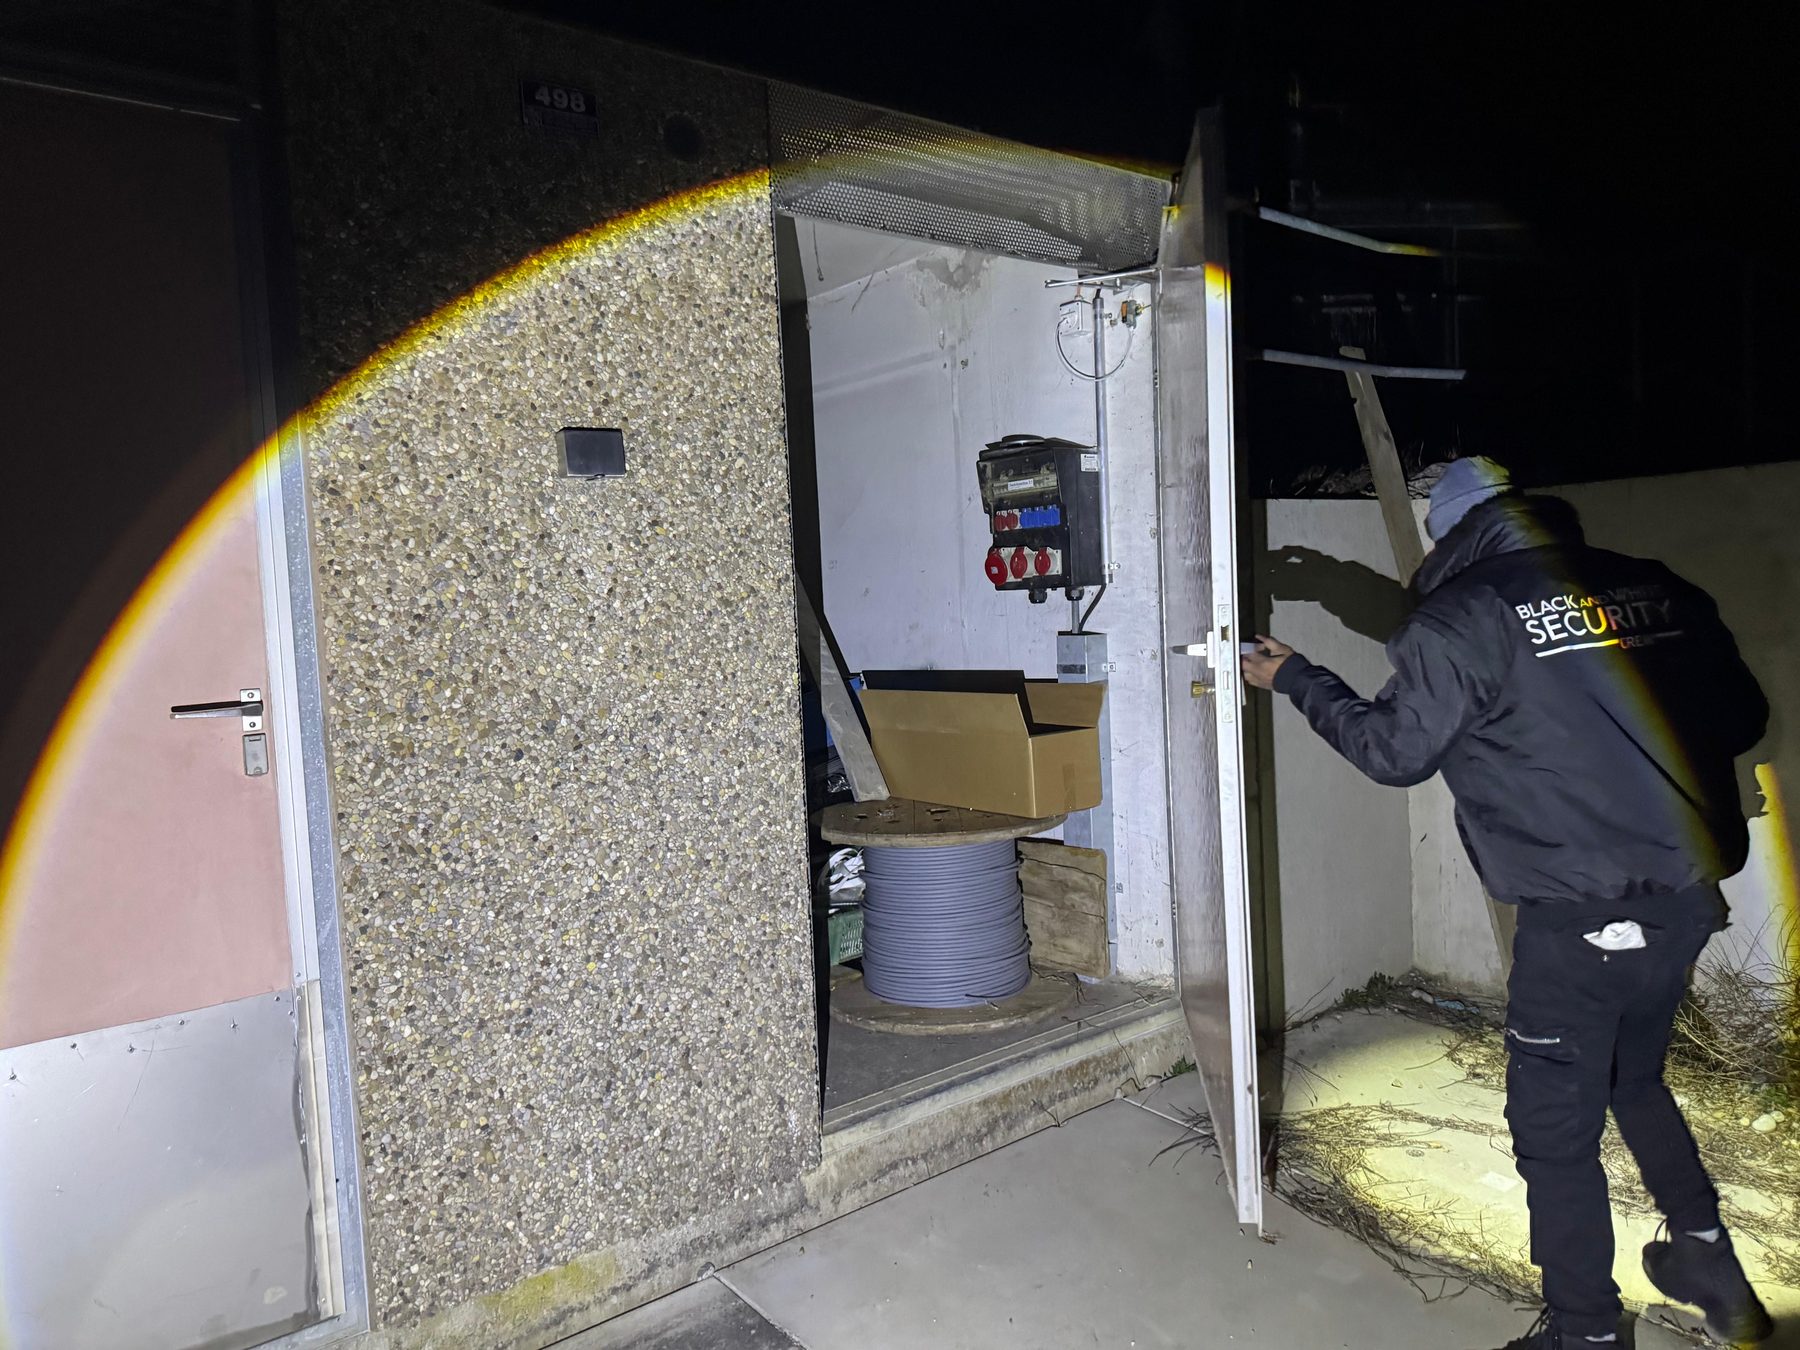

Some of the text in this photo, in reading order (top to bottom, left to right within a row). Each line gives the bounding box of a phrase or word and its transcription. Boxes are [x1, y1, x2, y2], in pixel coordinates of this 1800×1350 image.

[535, 86, 586, 112] 498
[1515, 594, 1579, 619] BLACK
[1525, 598, 1670, 644] SECURITY
